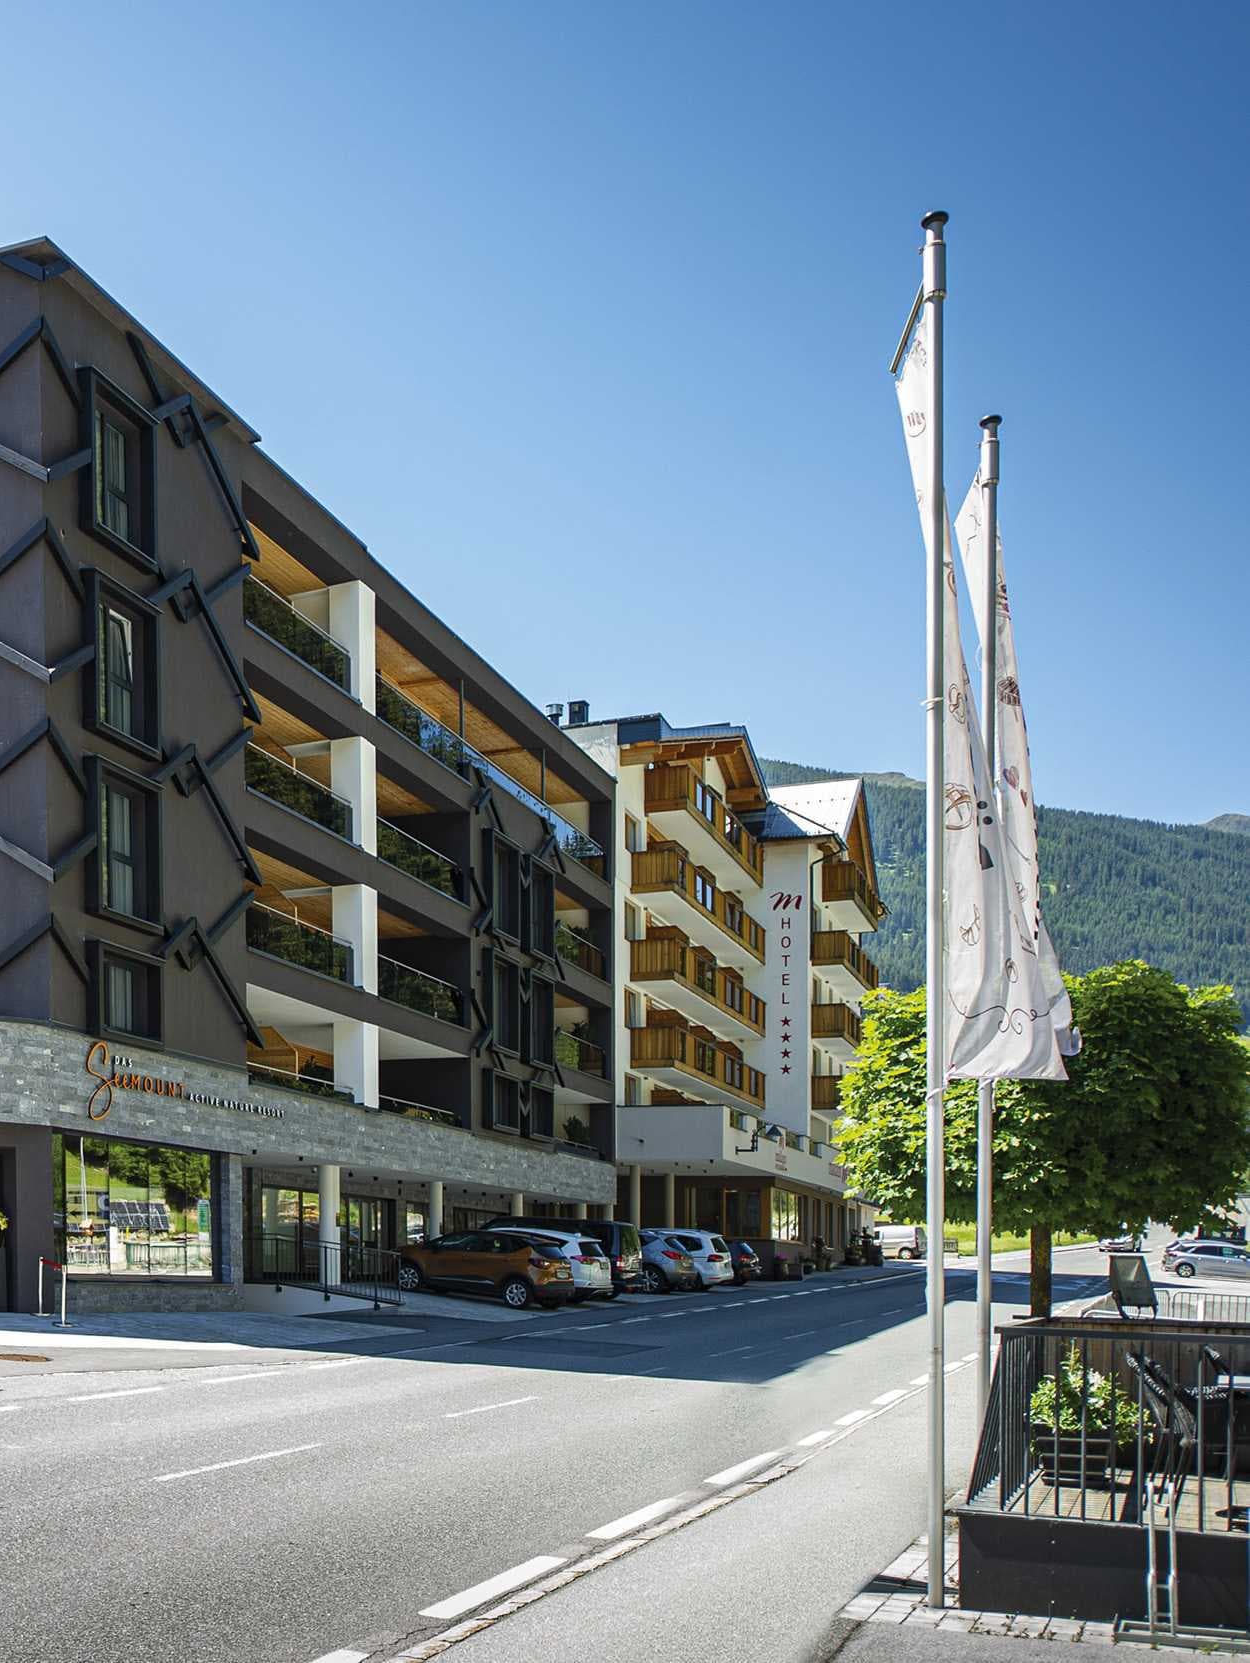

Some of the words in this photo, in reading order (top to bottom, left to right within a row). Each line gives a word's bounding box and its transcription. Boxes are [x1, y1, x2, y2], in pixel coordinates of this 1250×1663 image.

[780, 917, 791, 1005] HOTEL
[115, 1055, 133, 1068] DAS
[190, 1092, 219, 1107] ACTIVE
[223, 1100, 254, 1113] NATURE
[258, 1105, 285, 1119] RESORT
